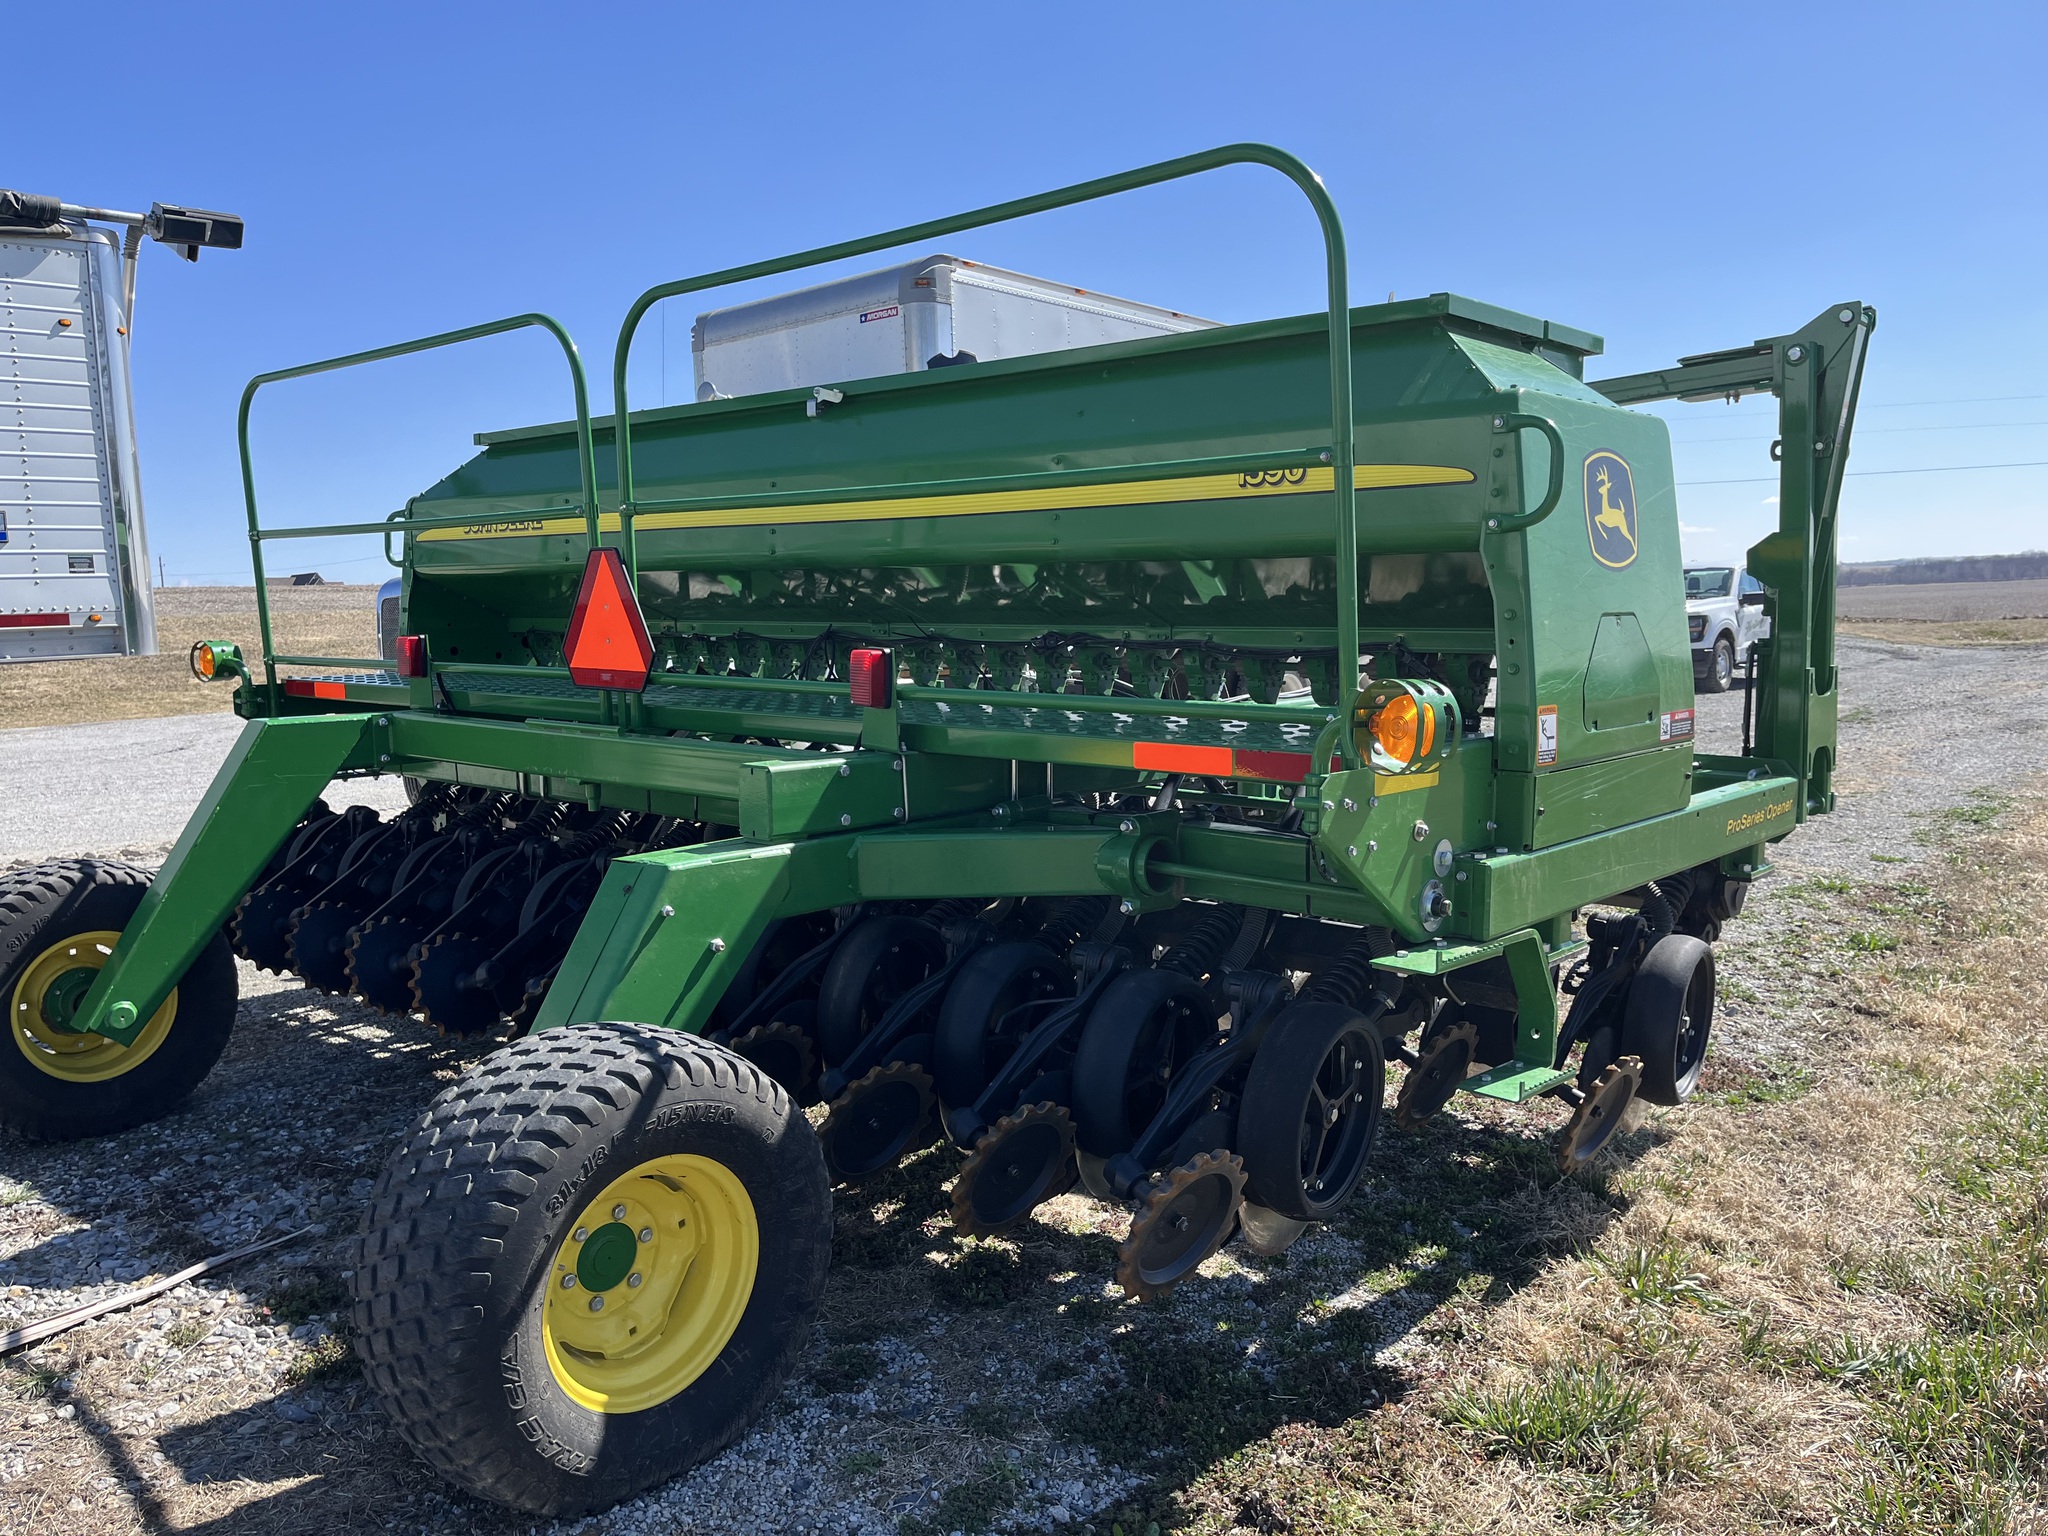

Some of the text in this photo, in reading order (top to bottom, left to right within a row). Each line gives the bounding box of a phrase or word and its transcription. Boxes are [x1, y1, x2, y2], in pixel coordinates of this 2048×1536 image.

[866, 308, 898, 321] MORGAN
[1726, 799, 1794, 836] ProSeries Opener
